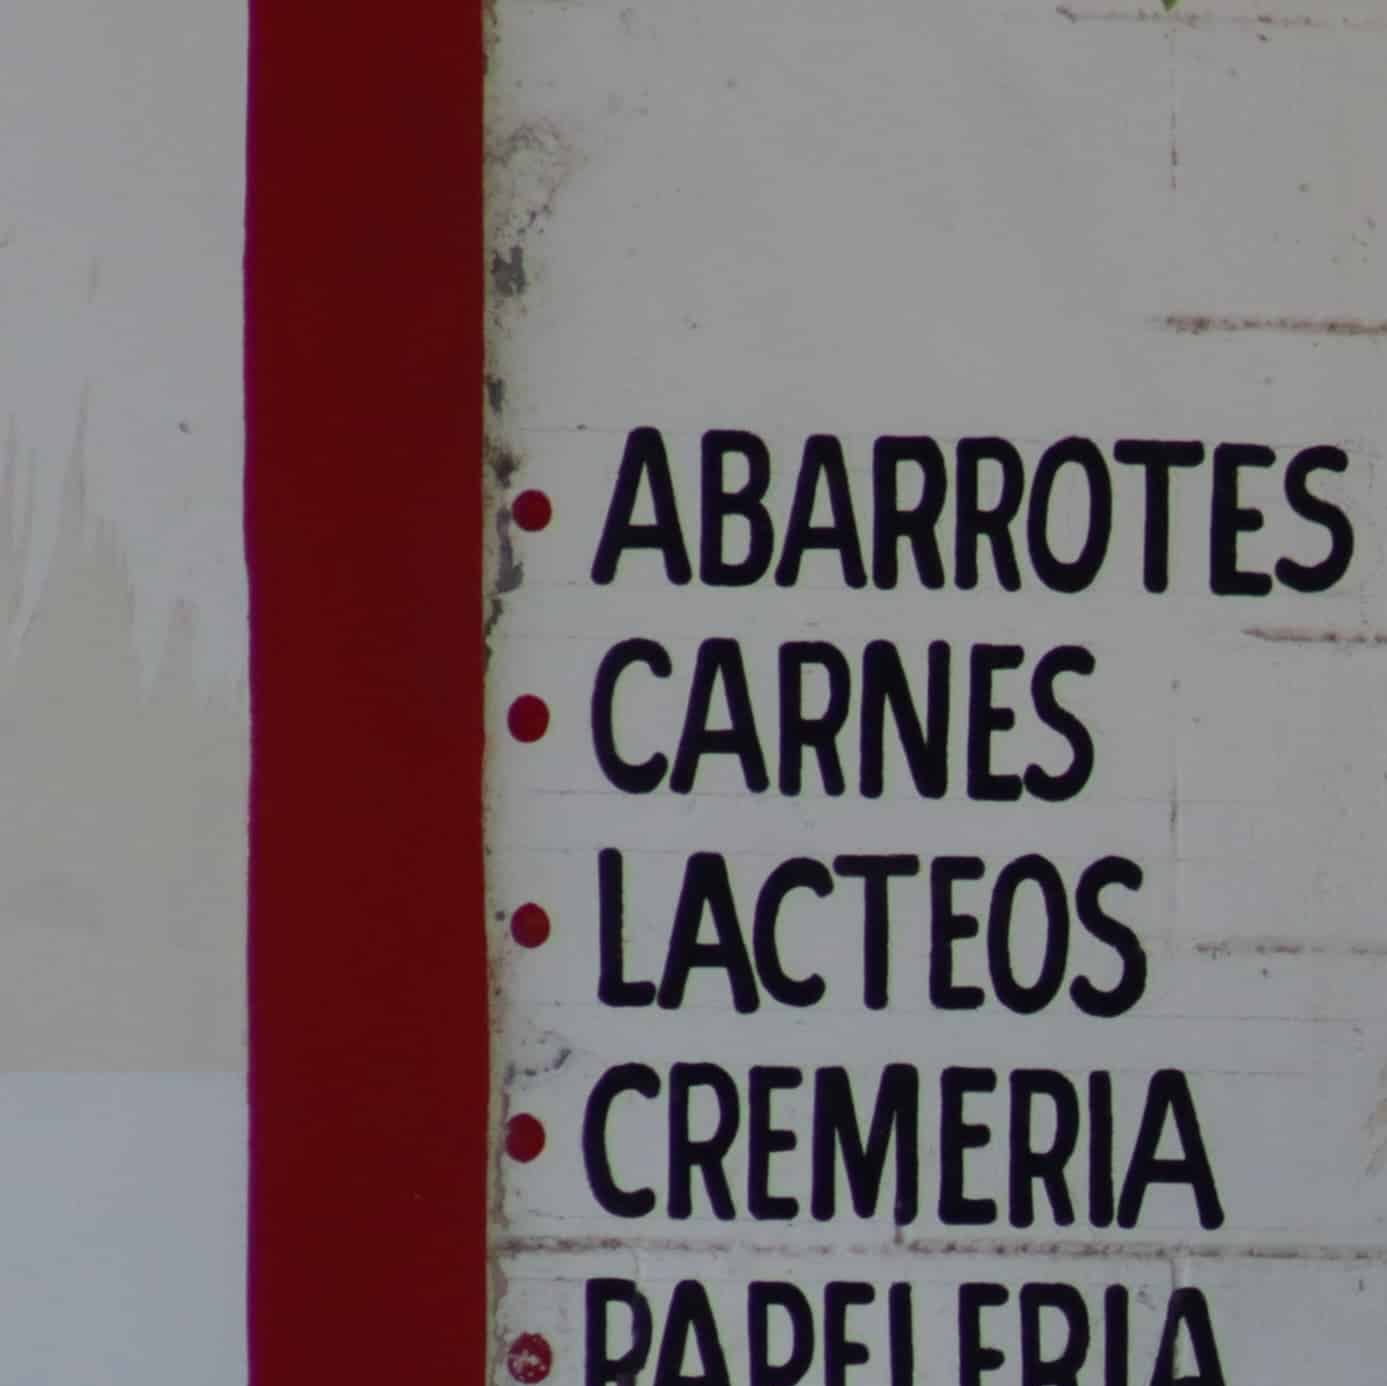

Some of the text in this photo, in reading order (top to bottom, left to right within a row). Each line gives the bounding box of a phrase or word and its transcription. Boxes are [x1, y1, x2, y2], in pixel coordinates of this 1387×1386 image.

[592, 427, 1353, 596] ABARROTES
[592, 638, 1095, 801] CARNES
[598, 848, 1146, 1017] LACTEOS
[583, 1062, 1224, 1229] CREMERIA
